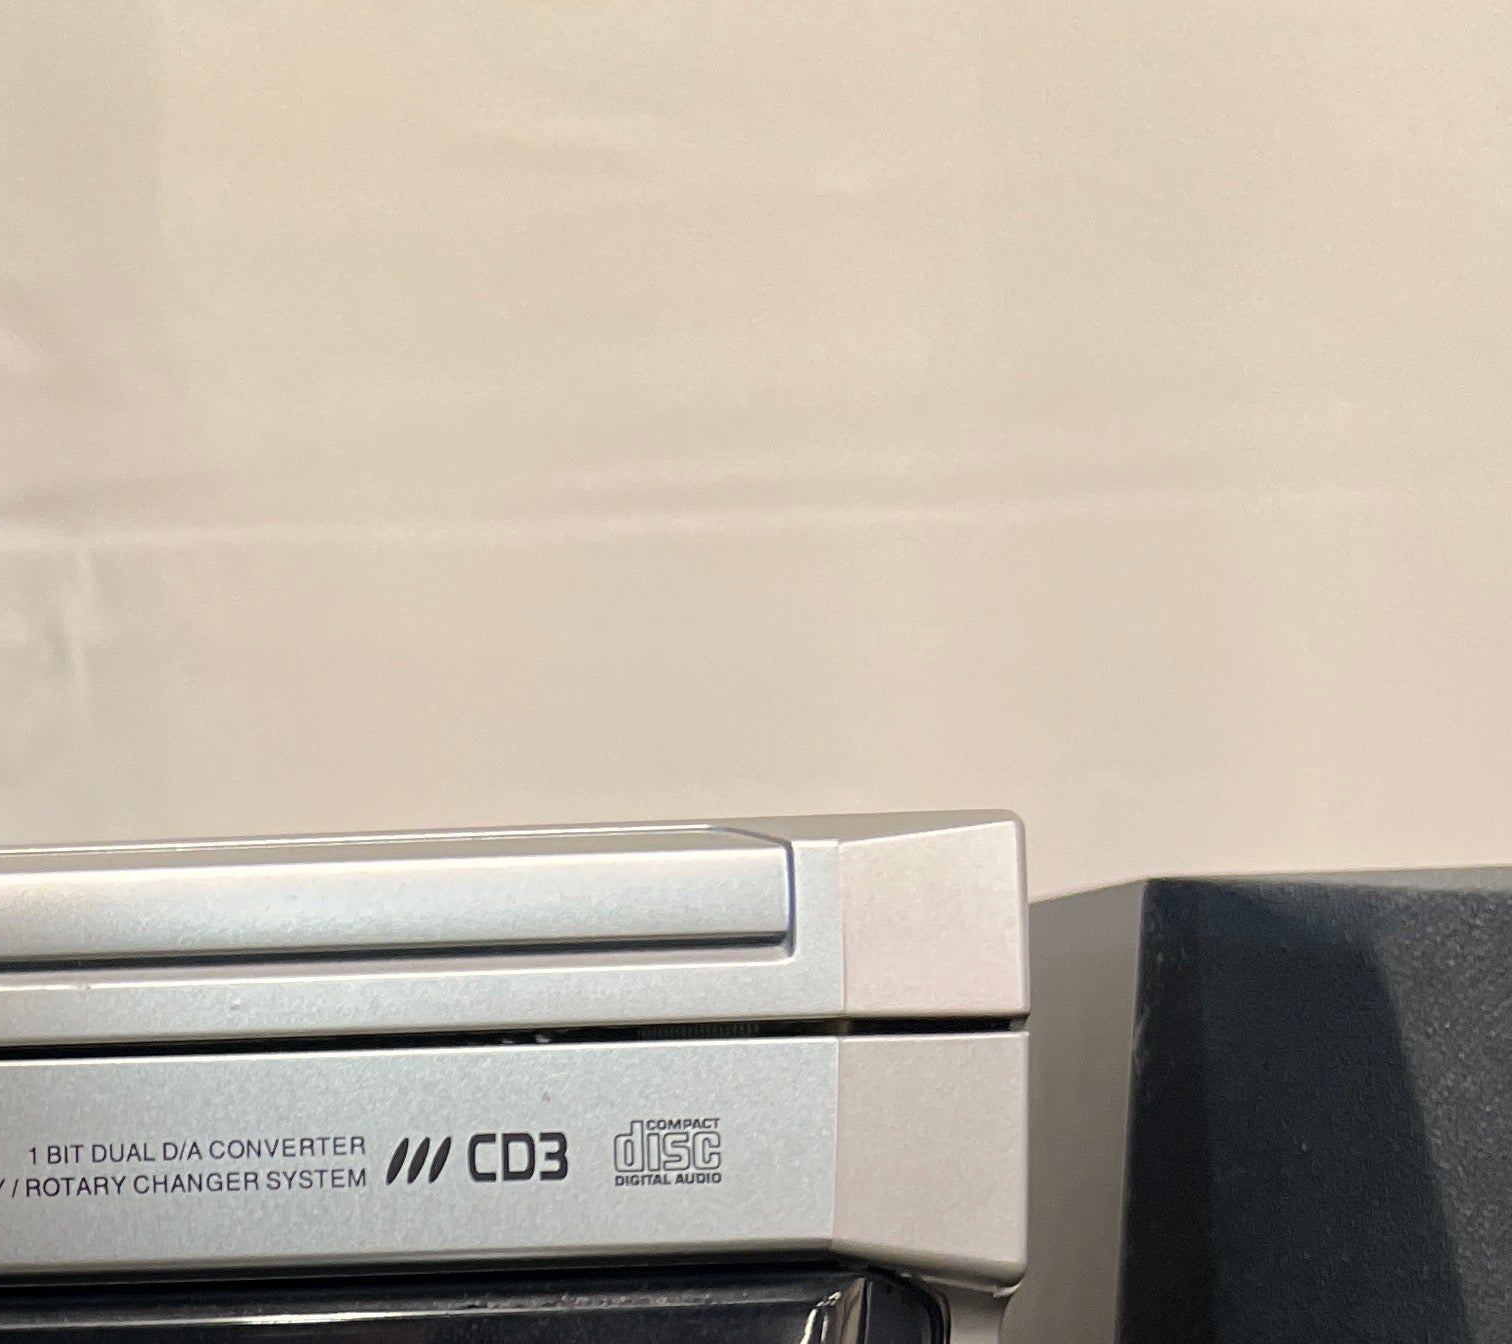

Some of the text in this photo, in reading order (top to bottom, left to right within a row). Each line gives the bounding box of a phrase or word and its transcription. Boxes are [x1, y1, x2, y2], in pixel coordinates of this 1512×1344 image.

[645, 1117, 721, 1131] COMPACT
[46, 1144, 85, 1165] BIT
[91, 1142, 156, 1164] DUAL
[162, 1140, 203, 1162] D/A
[208, 1136, 367, 1160] CONVERTER
[467, 1131, 569, 1183] CD3
[613, 1119, 722, 1174] disc
[25, 1175, 127, 1198] ROTARY
[132, 1171, 260, 1195] CHANGER
[266, 1167, 367, 1191] SYSTEM
[613, 1171, 723, 1187] DIGITAL AUDIO
